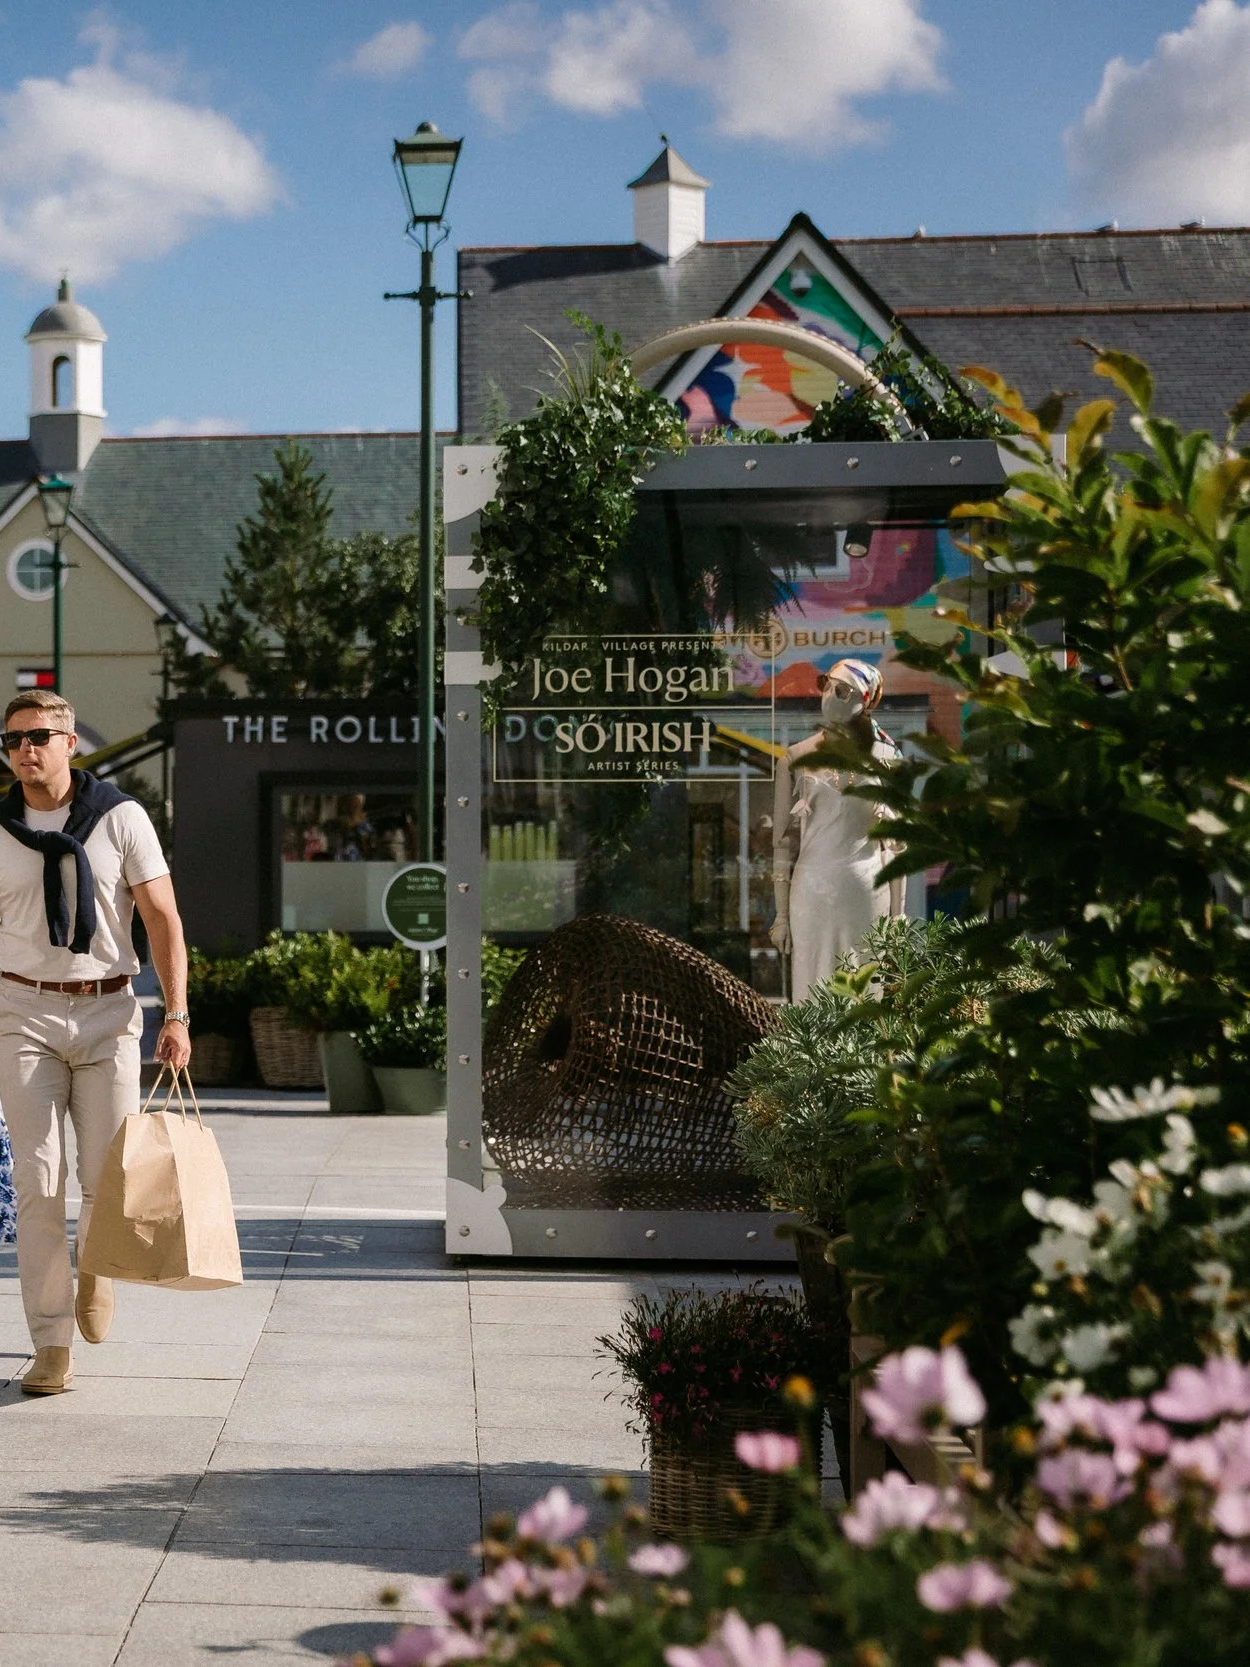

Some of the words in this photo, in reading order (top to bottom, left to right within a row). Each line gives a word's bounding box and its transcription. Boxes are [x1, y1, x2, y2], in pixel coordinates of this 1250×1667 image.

[542, 642, 589, 652] KILDAR
[602, 641, 656, 651] VILLAGE
[793, 630, 887, 647] BURCH
[532, 658, 592, 701] Joe
[605, 657, 735, 703] Hogan
[222, 716, 288, 743] THE
[310, 716, 447, 743] ROLLIN
[614, 721, 711, 753] IRISH
[587, 762, 630, 771] ARTIST
[636, 761, 679, 772] SERIES
